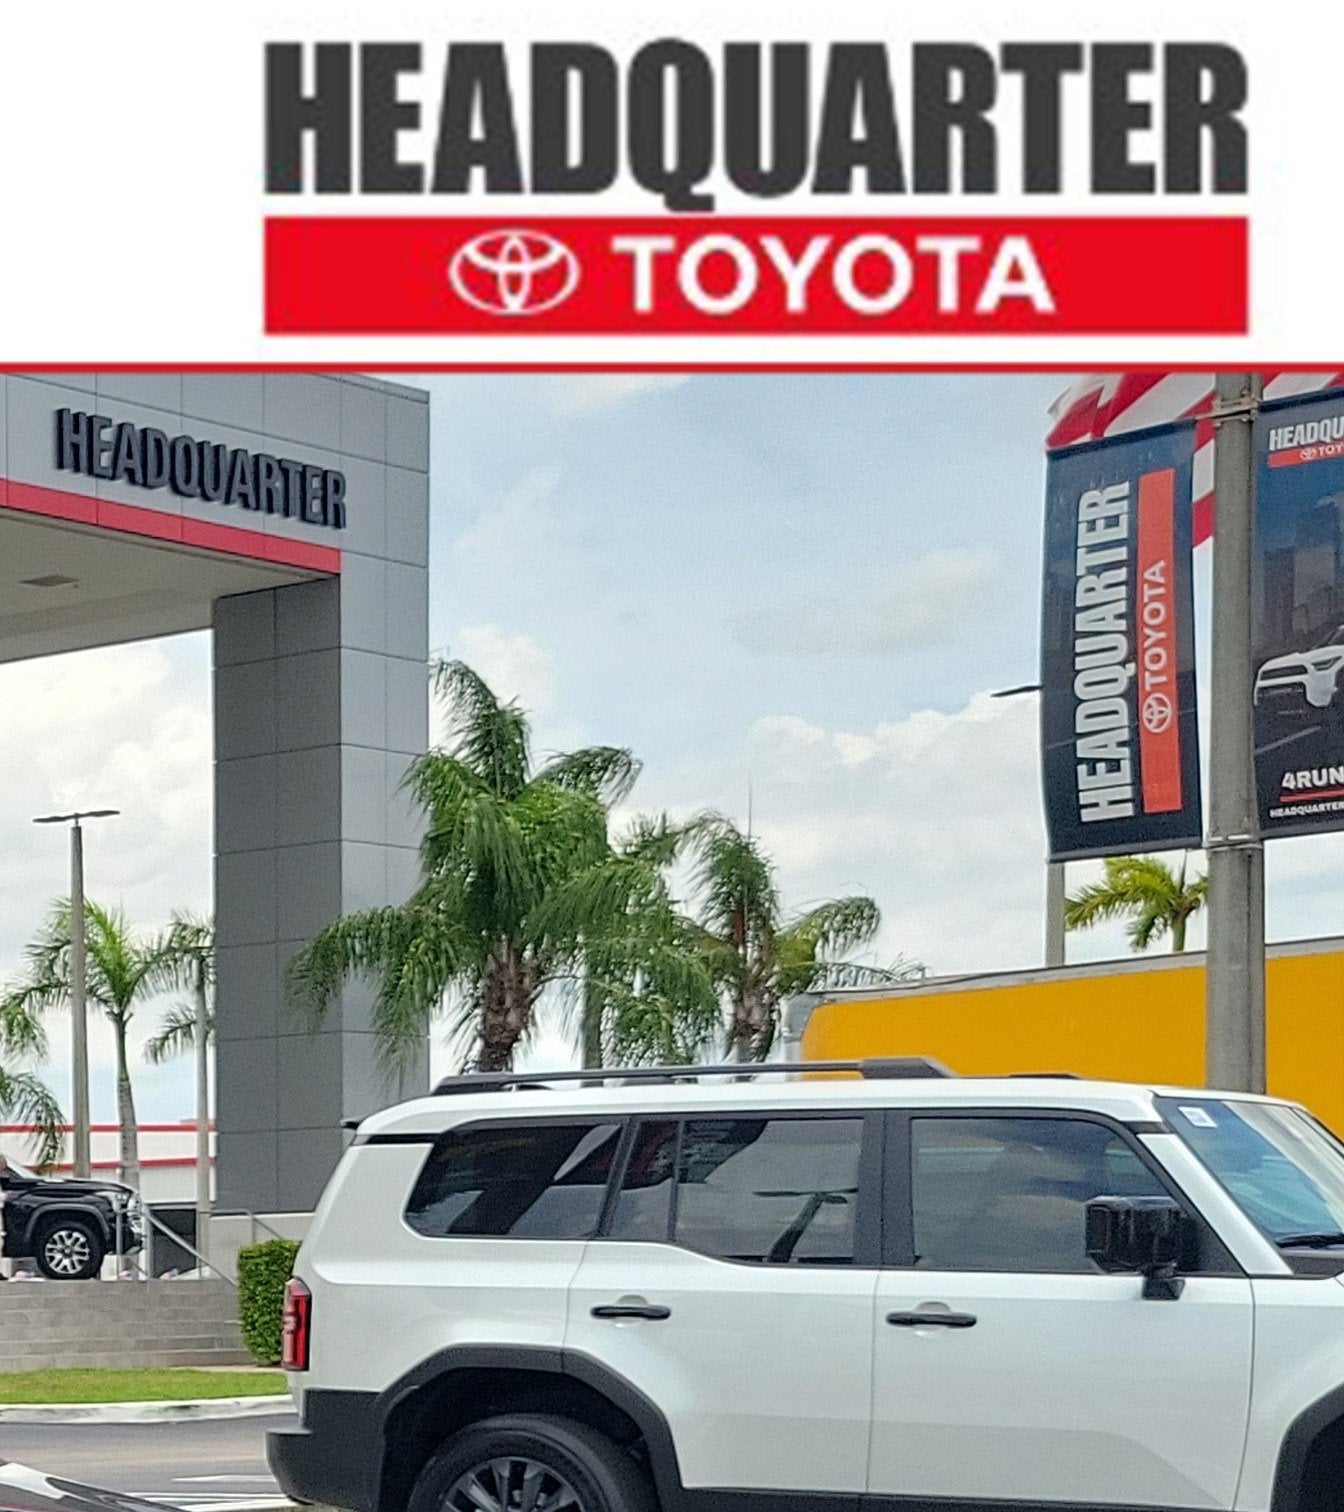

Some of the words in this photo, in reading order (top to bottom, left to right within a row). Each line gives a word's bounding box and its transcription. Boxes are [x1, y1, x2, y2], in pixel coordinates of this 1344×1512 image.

[54, 407, 348, 530] HEADQUARTER
[1074, 480, 1136, 823] HEADQUARTER
[1143, 560, 1168, 691] TOYOTA
